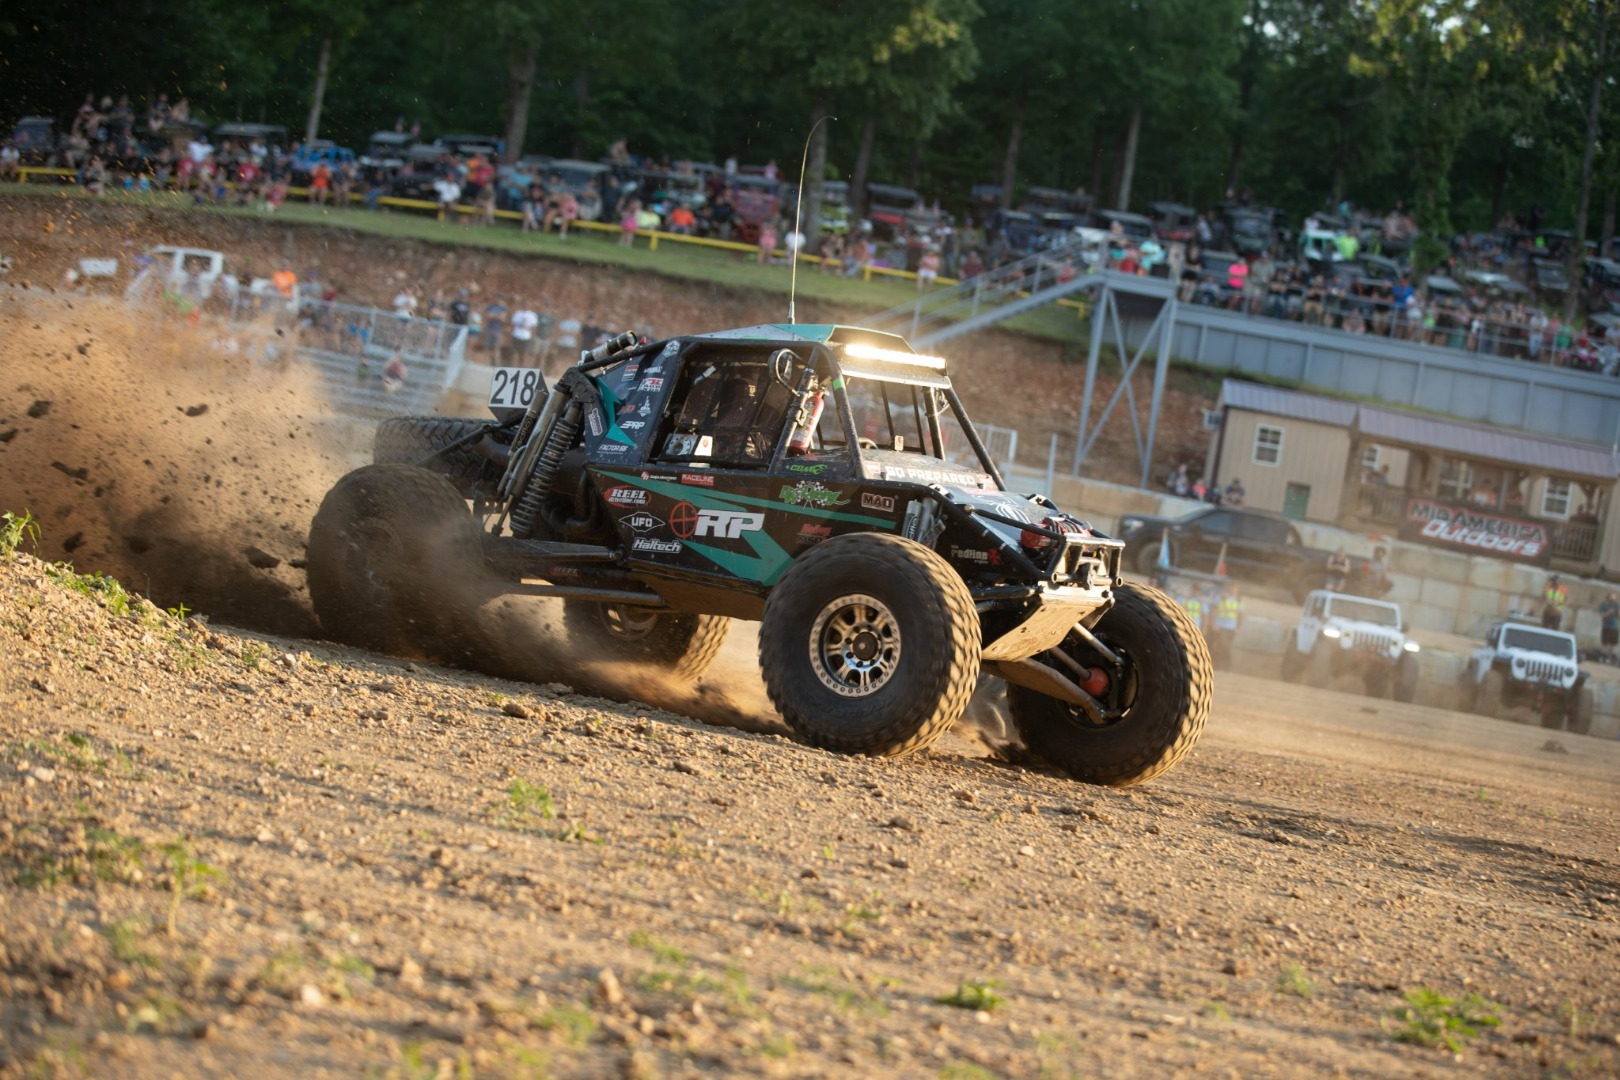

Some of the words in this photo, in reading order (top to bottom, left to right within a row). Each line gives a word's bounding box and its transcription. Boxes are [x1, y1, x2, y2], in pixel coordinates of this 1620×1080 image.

[490, 370, 536, 406] 218
[681, 474, 714, 483] RACELINE
[907, 469, 975, 486] PREPARED
[611, 489, 646, 499] REEL
[864, 495, 893, 508] MAD
[631, 517, 653, 527] UFO
[1453, 512, 1542, 541] AMERICA
[633, 539, 681, 552] Haltech
[950, 549, 988, 560] redline
